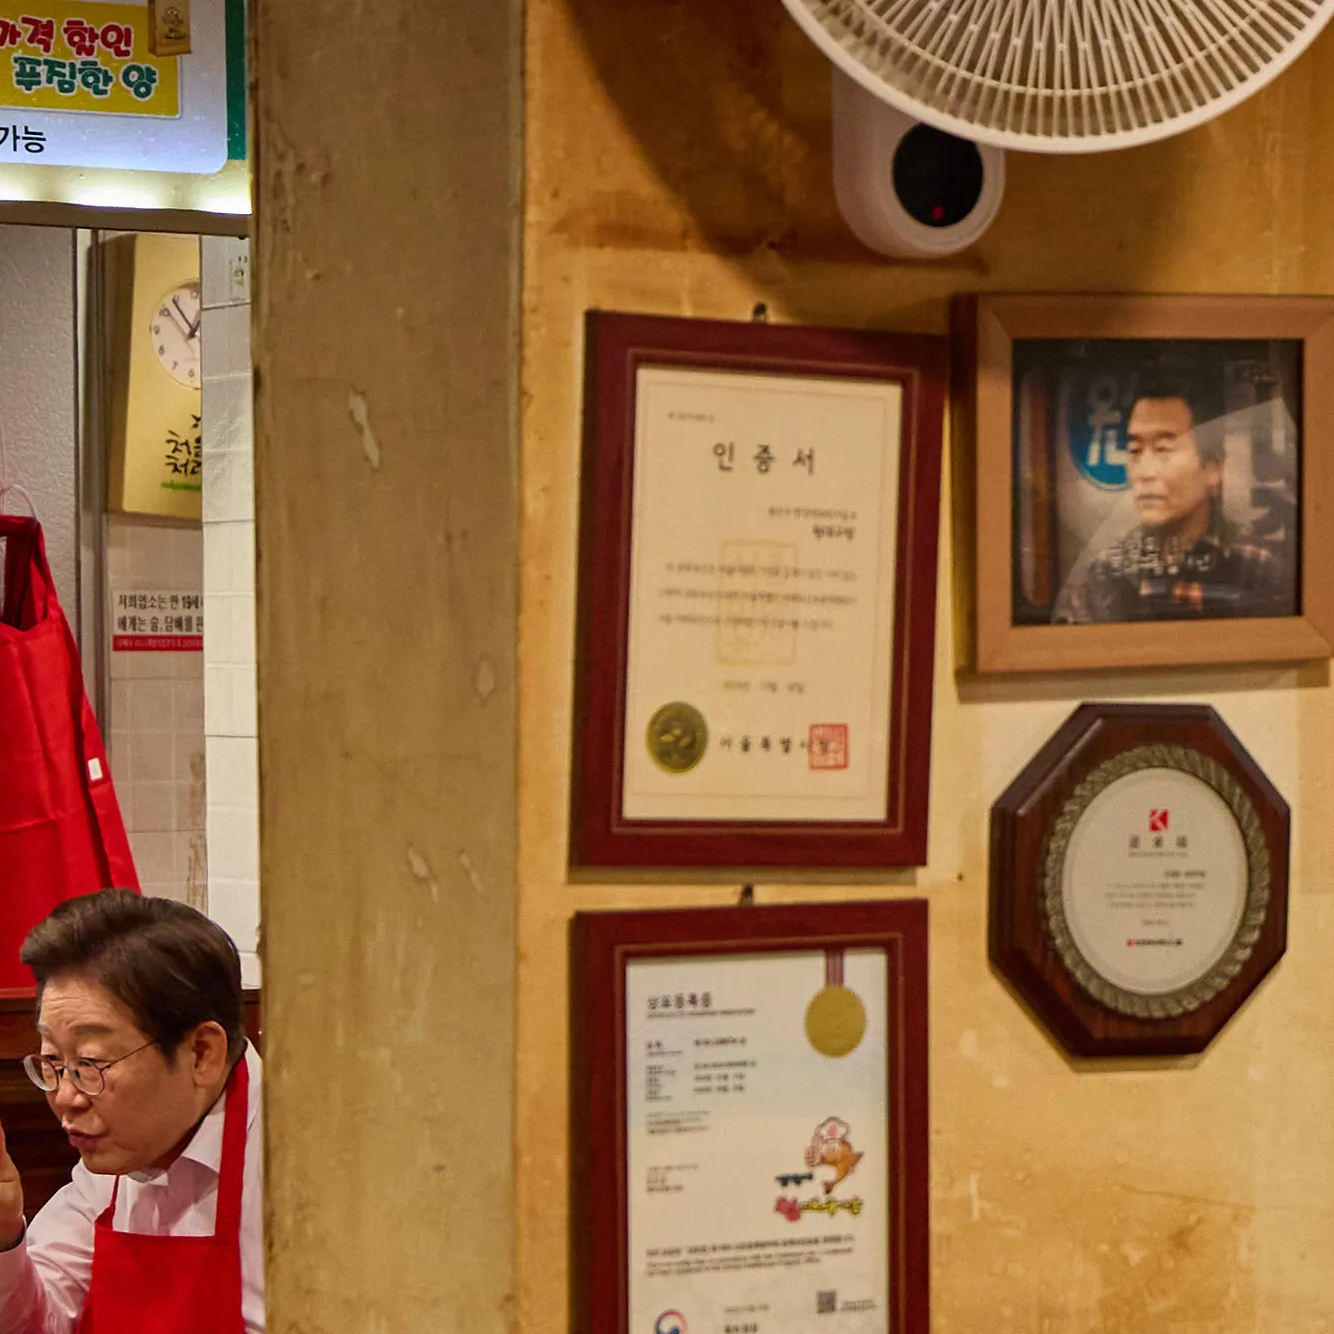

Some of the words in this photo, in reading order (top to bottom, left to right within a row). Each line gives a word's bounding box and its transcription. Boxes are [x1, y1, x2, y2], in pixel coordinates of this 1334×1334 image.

[63, 18, 134, 58] 할인
[13, 55, 114, 96] 푸짐한
[121, 63, 158, 99] 양
